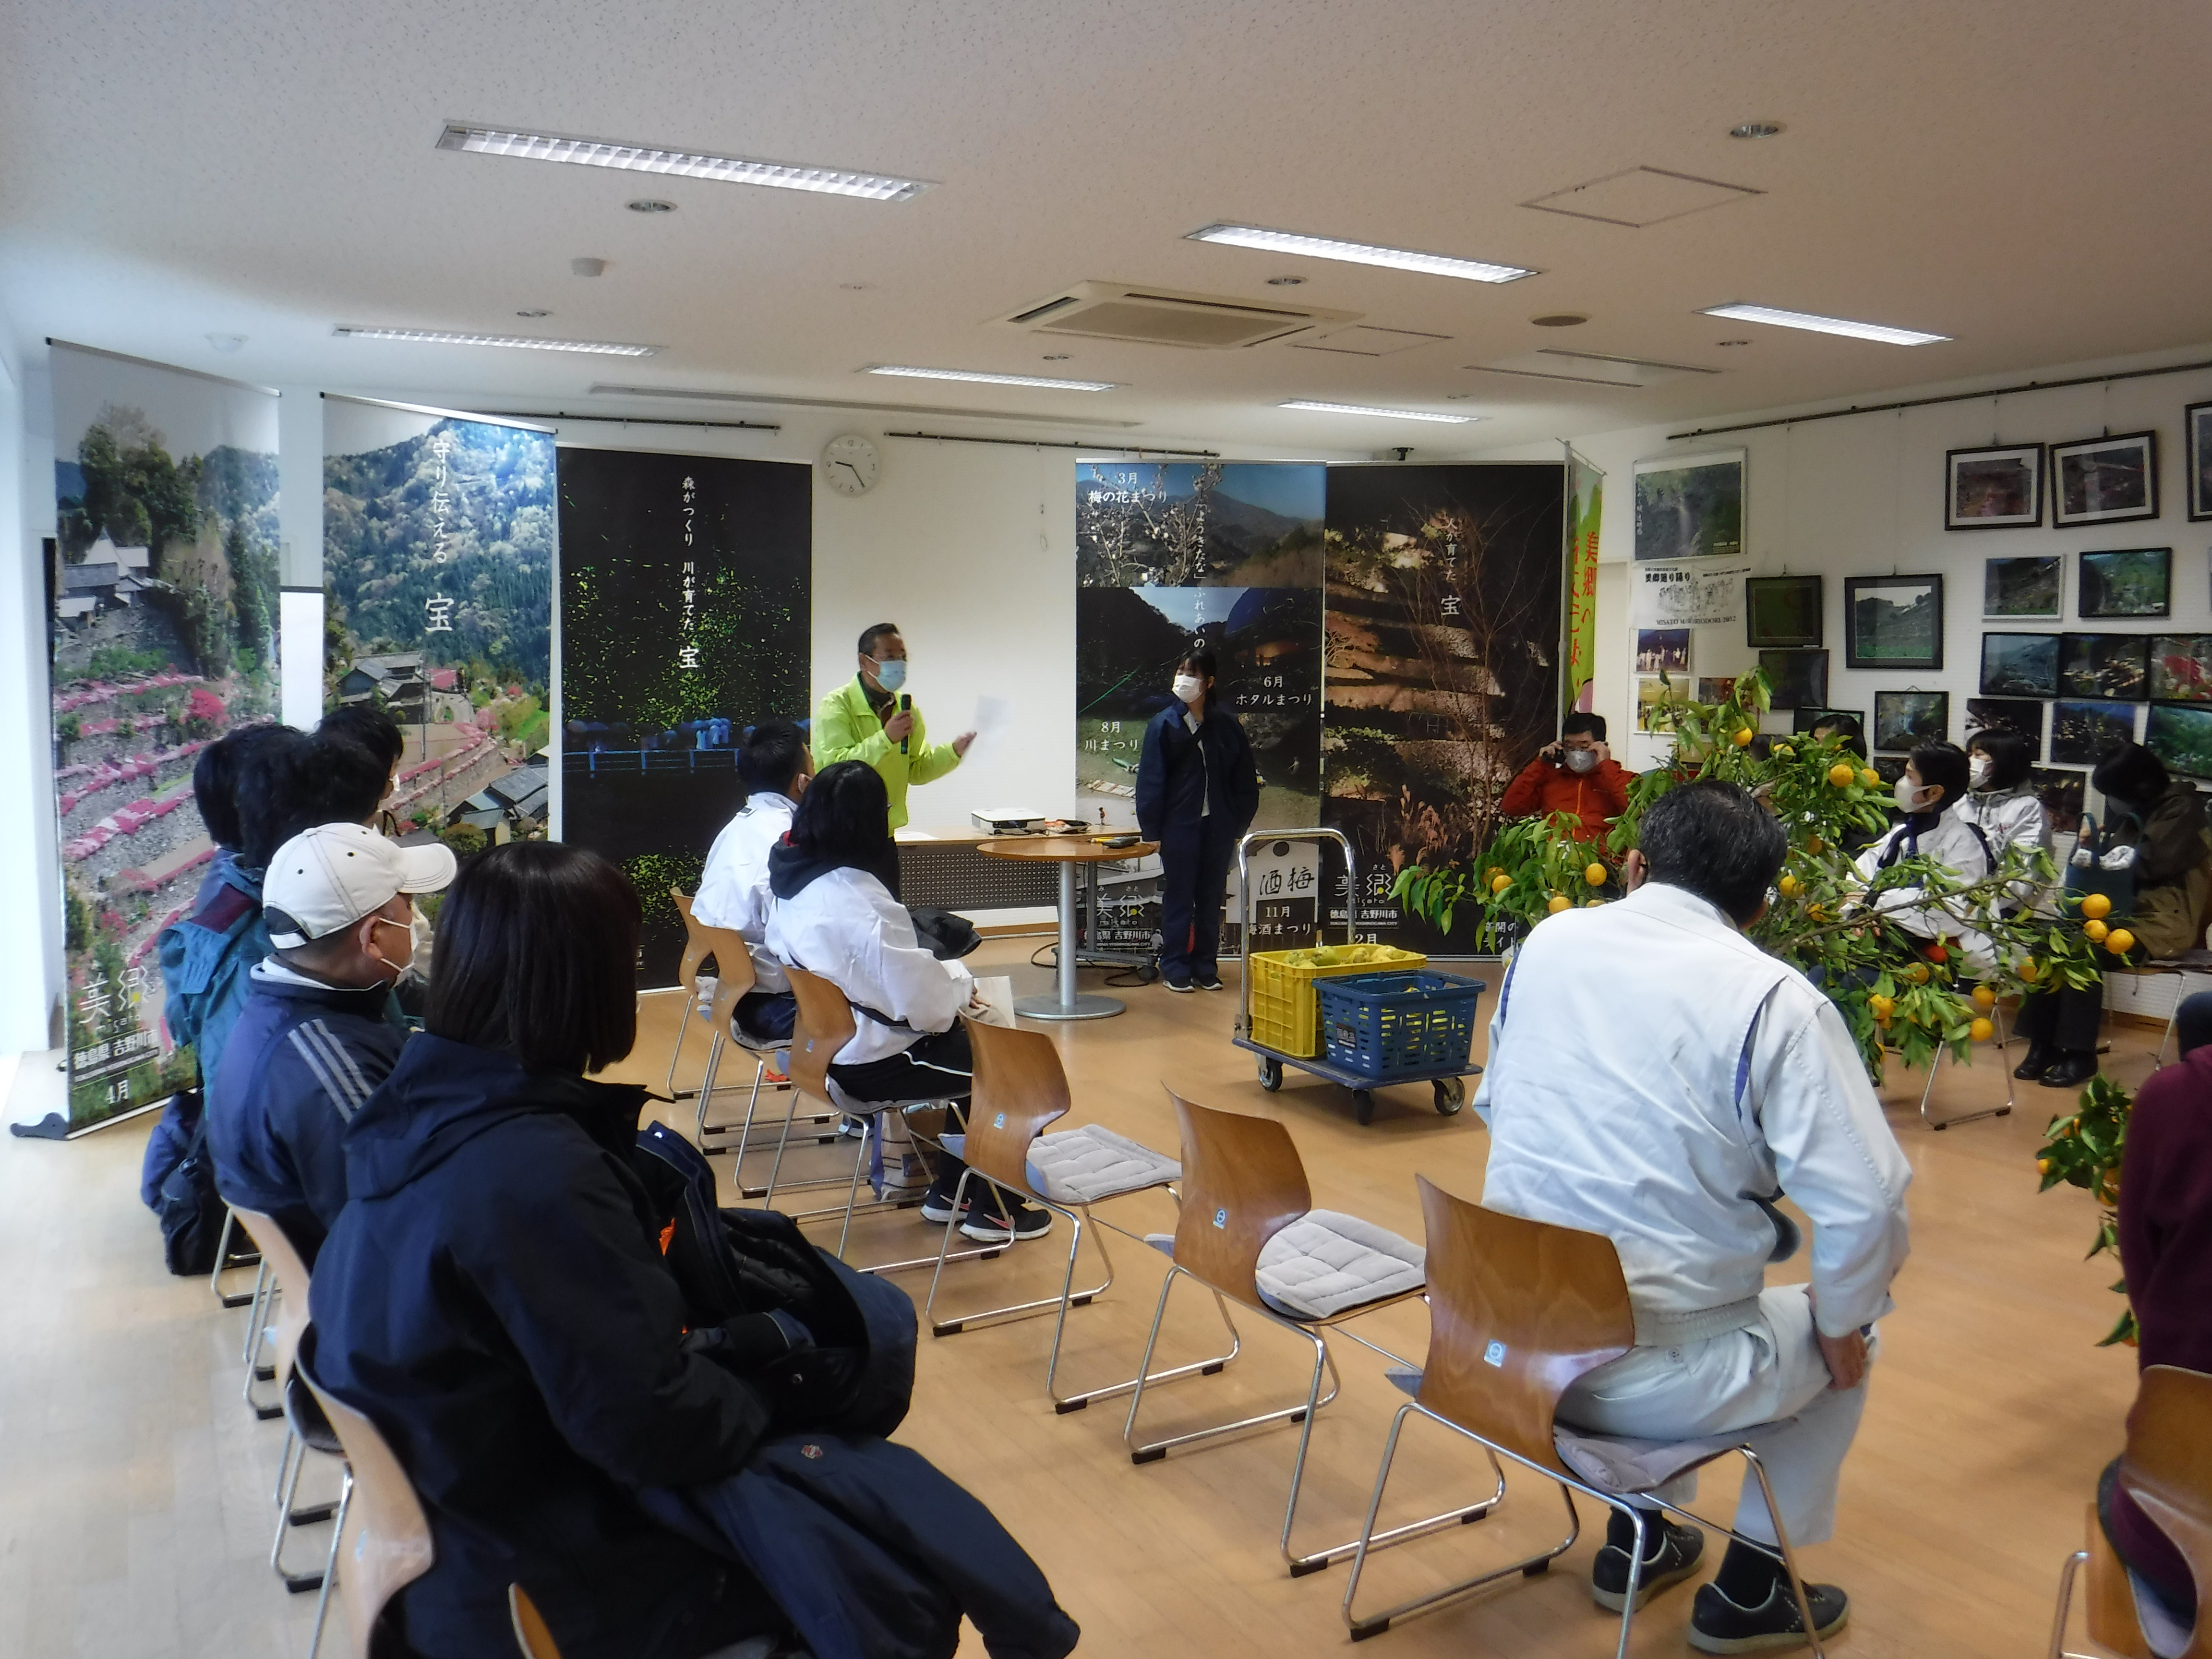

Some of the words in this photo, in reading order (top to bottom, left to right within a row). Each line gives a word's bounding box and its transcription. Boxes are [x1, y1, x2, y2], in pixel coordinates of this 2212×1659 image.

[1118, 472, 1137, 485] 3月
[433, 439, 451, 564] 守り伝える
[1088, 490, 1166, 504] 梅の花まつり
[682, 476, 696, 547] 森がつくり
[1445, 518, 1458, 581] 人が育てた
[682, 561, 696, 630] 川が育てた
[425, 592, 455, 632] 宝
[1441, 594, 1462, 616] 宝
[1194, 587, 1206, 648] ふれあいの
[679, 646, 700, 669] 宝
[1263, 676, 1283, 688] 6月
[1236, 694, 1312, 706] ホタルまつり
[1101, 721, 1120, 733] 8月
[1084, 739, 1138, 751] 川まつり
[1265, 906, 1291, 917] 11月
[1360, 909, 1397, 919] 吉野川市
[1114, 930, 1151, 940] 吉野川市
